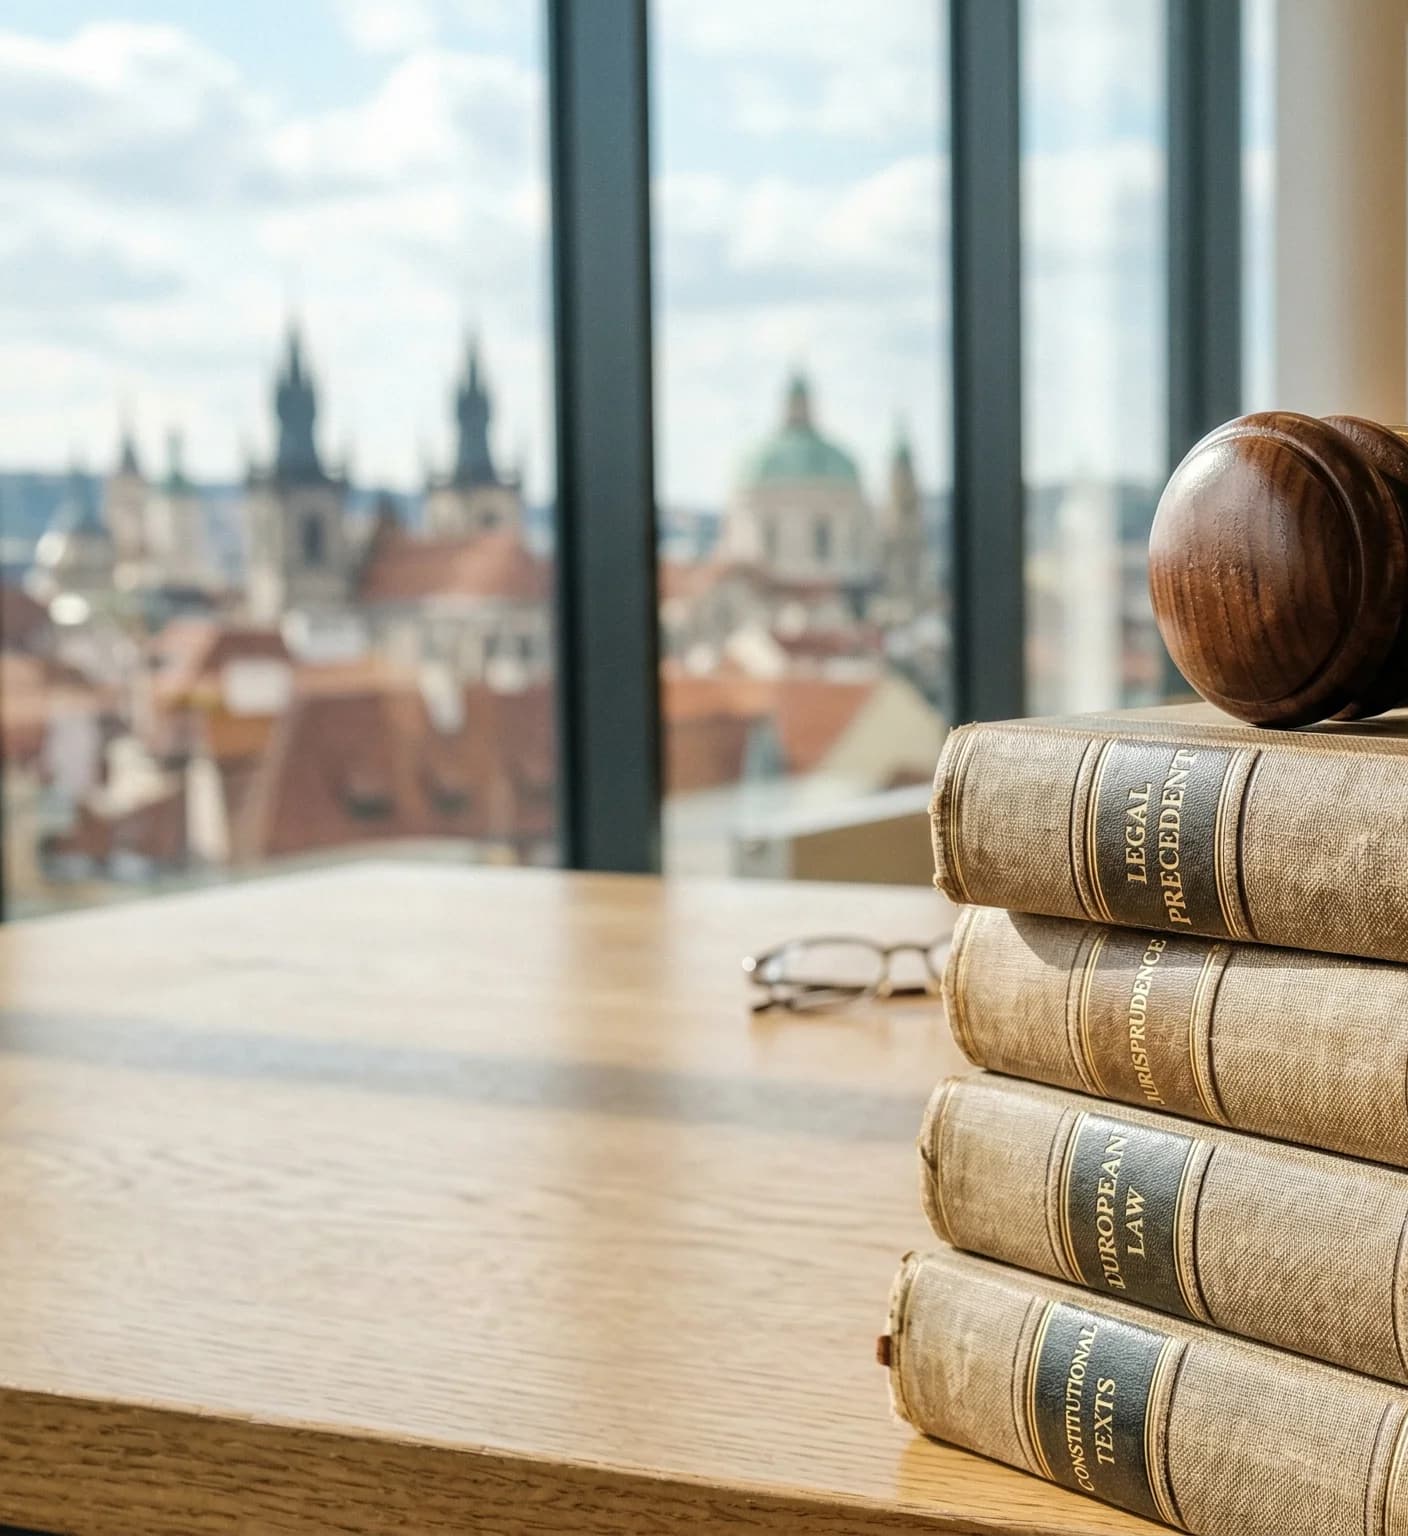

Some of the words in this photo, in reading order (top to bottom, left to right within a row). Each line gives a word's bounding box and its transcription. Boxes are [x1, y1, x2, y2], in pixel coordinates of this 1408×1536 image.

[1126, 782, 1152, 885] LEGAL
[1159, 750, 1199, 925] PRECEDENT
[1129, 938, 1167, 1105] JURISPRUDENCE
[1126, 1186, 1147, 1259] LAW
[1066, 1325, 1098, 1492] CONSTITUTIONAL
[1094, 1377, 1116, 1465] TEXTS
